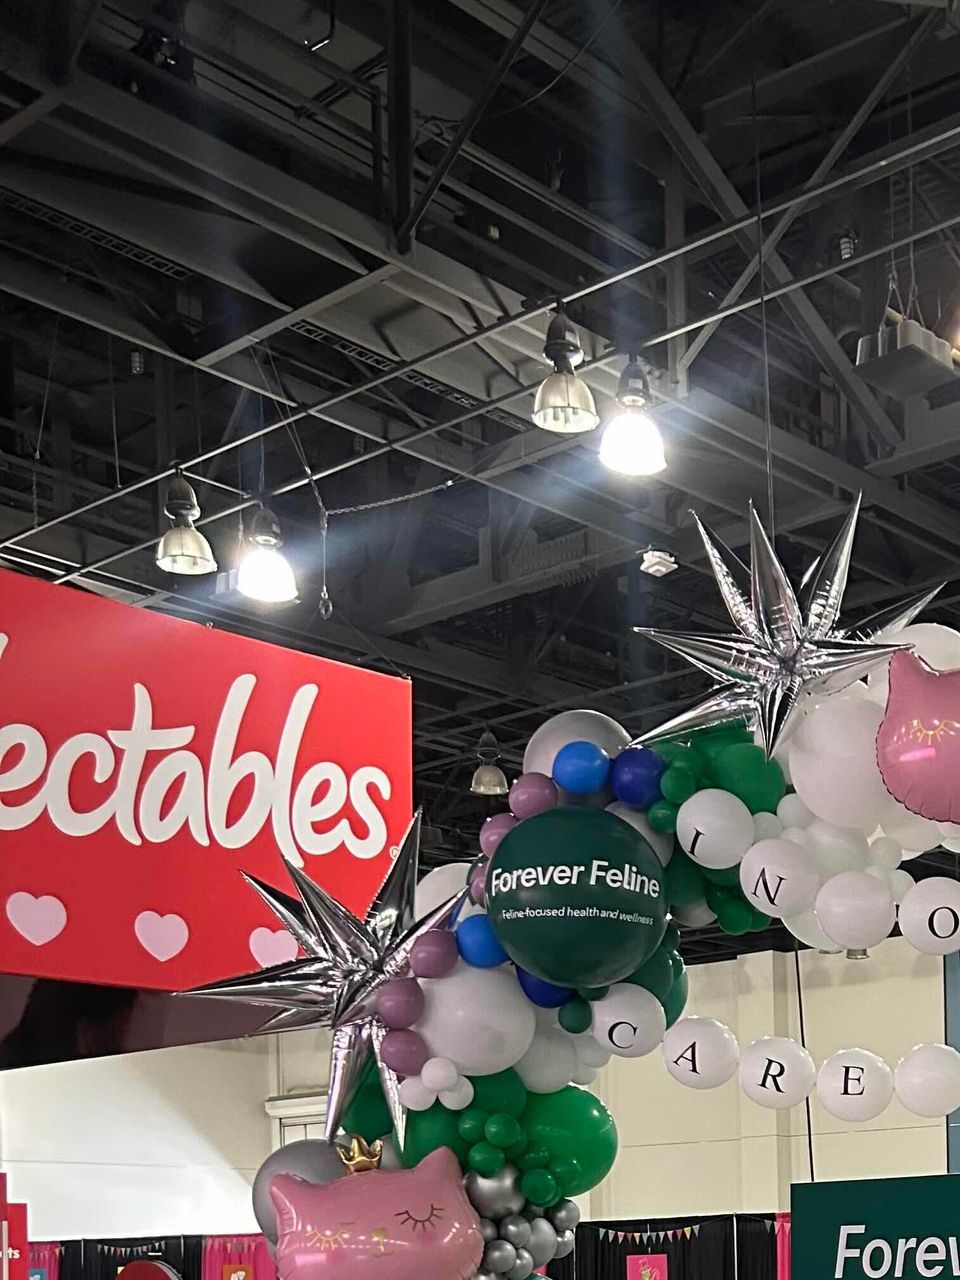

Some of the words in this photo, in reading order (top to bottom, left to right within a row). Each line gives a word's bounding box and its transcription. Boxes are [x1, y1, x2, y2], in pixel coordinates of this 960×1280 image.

[0, 632, 391, 868] ectables
[491, 864, 585, 897] Forever
[589, 860, 660, 898] Feline
[502, 906, 565, 920] Feline-focused
[566, 906, 599, 918] health
[600, 908, 618, 920] and
[619, 911, 653, 926] wellness
